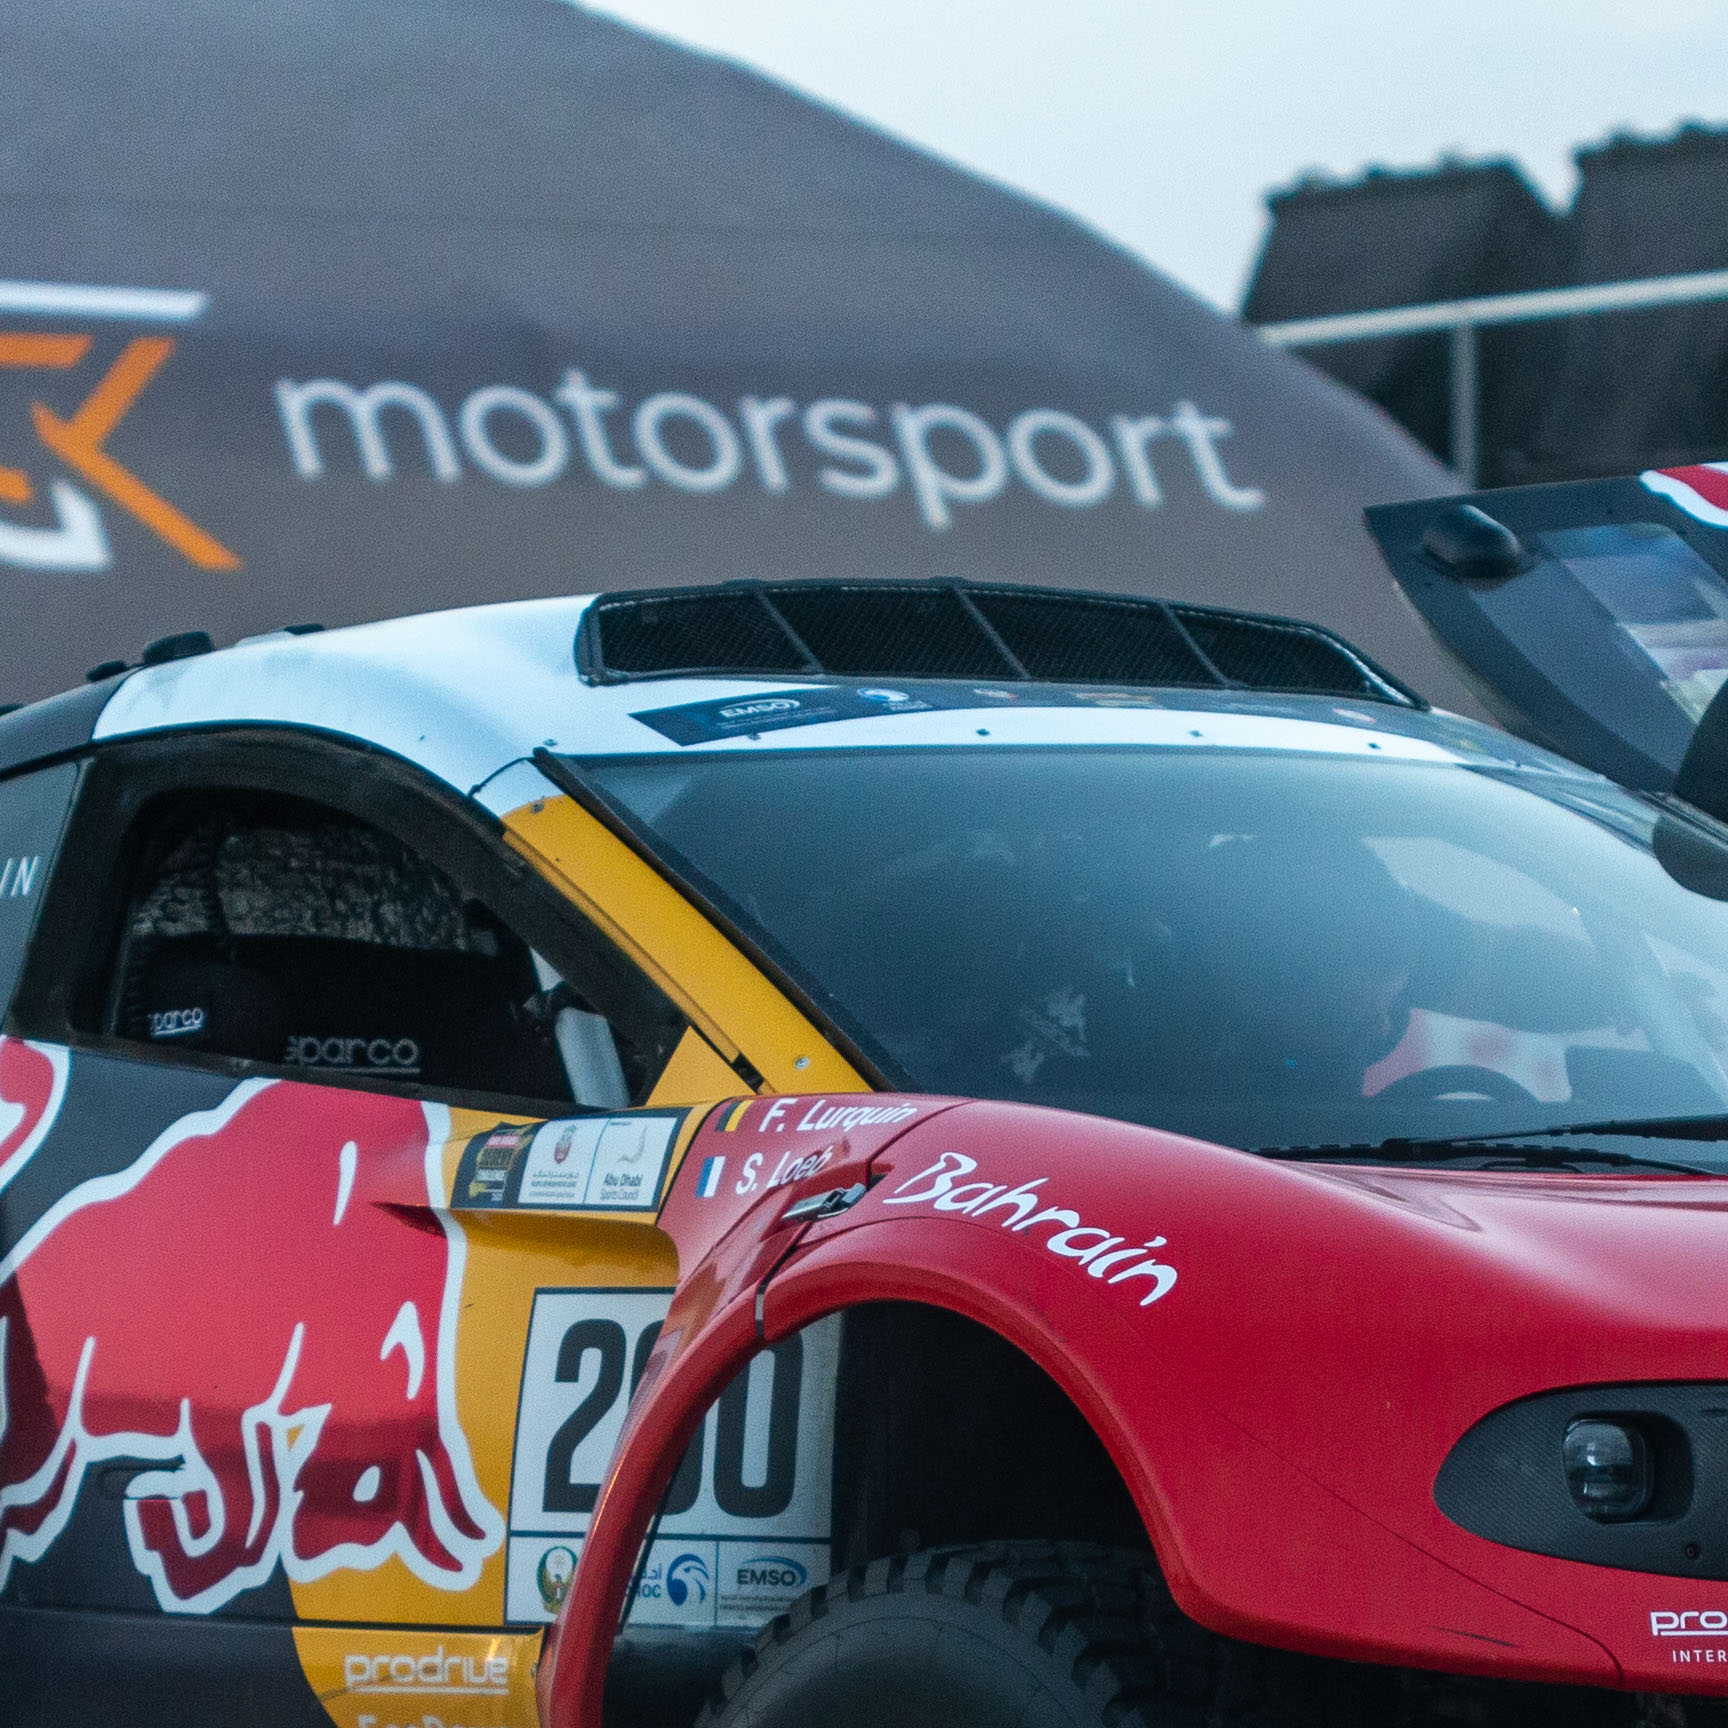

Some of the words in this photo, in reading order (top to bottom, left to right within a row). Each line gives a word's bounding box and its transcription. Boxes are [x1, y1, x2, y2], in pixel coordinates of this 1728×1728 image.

[275, 368, 1264, 529] motorsport
[759, 1098, 799, 1132] F.
[796, 1099, 918, 1133] Lurquin
[736, 1152, 764, 1195] S.
[766, 1145, 834, 1189] Loeb
[883, 1151, 1178, 1306] Bahrain
[736, 1568, 798, 1587] EMSO
[344, 1646, 508, 1692] prodrive
